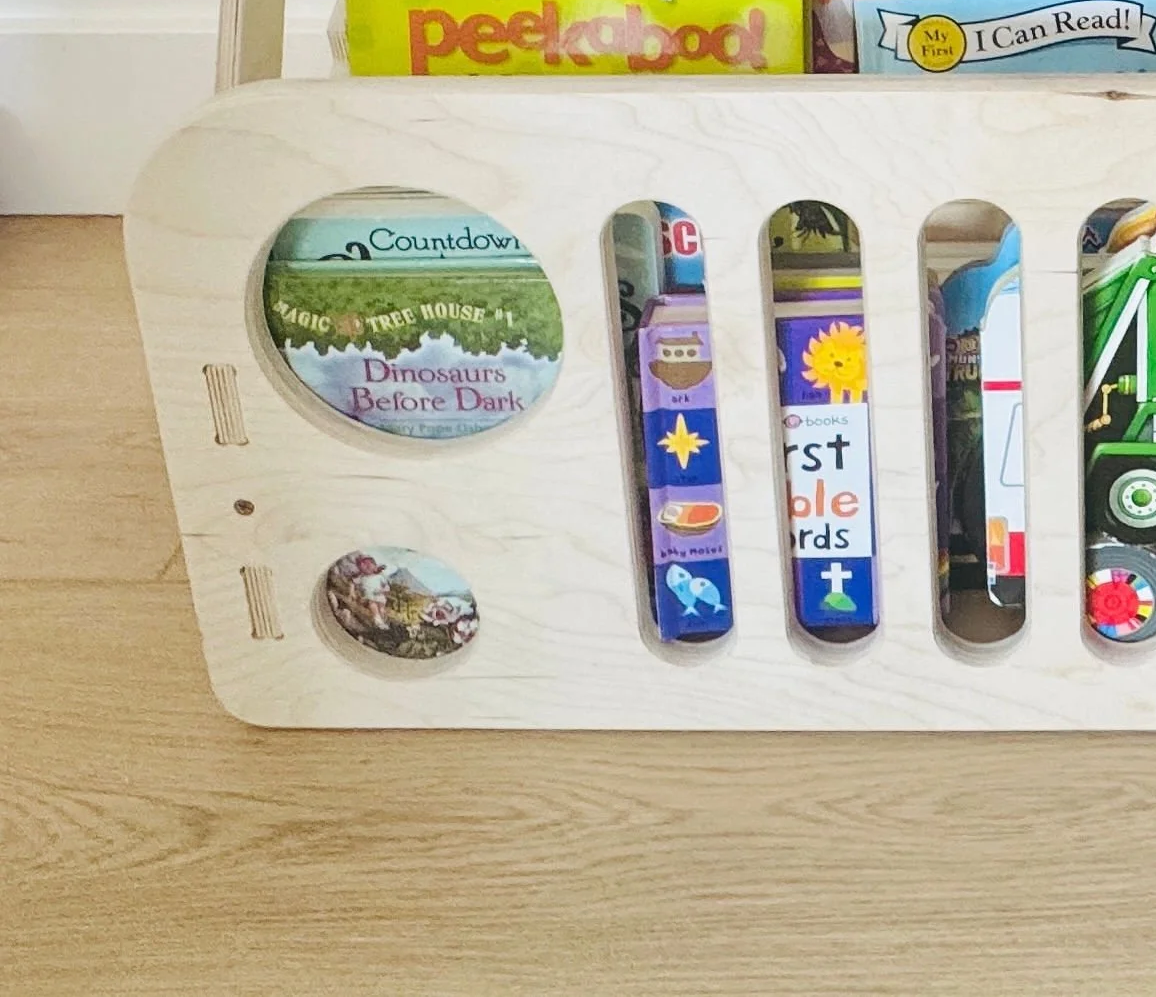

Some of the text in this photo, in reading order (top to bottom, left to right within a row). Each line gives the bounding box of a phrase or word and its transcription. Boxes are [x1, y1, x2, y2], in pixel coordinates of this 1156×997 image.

[923, 29, 950, 44] My
[974, 7, 1131, 52] I Can Read!
[921, 43, 954, 58] First
[272, 300, 515, 334] MAGIC TREE HOUSE #1
[364, 358, 507, 385] Dinosaurs
[352, 386, 525, 415] Before Dark
[805, 414, 849, 428] books
